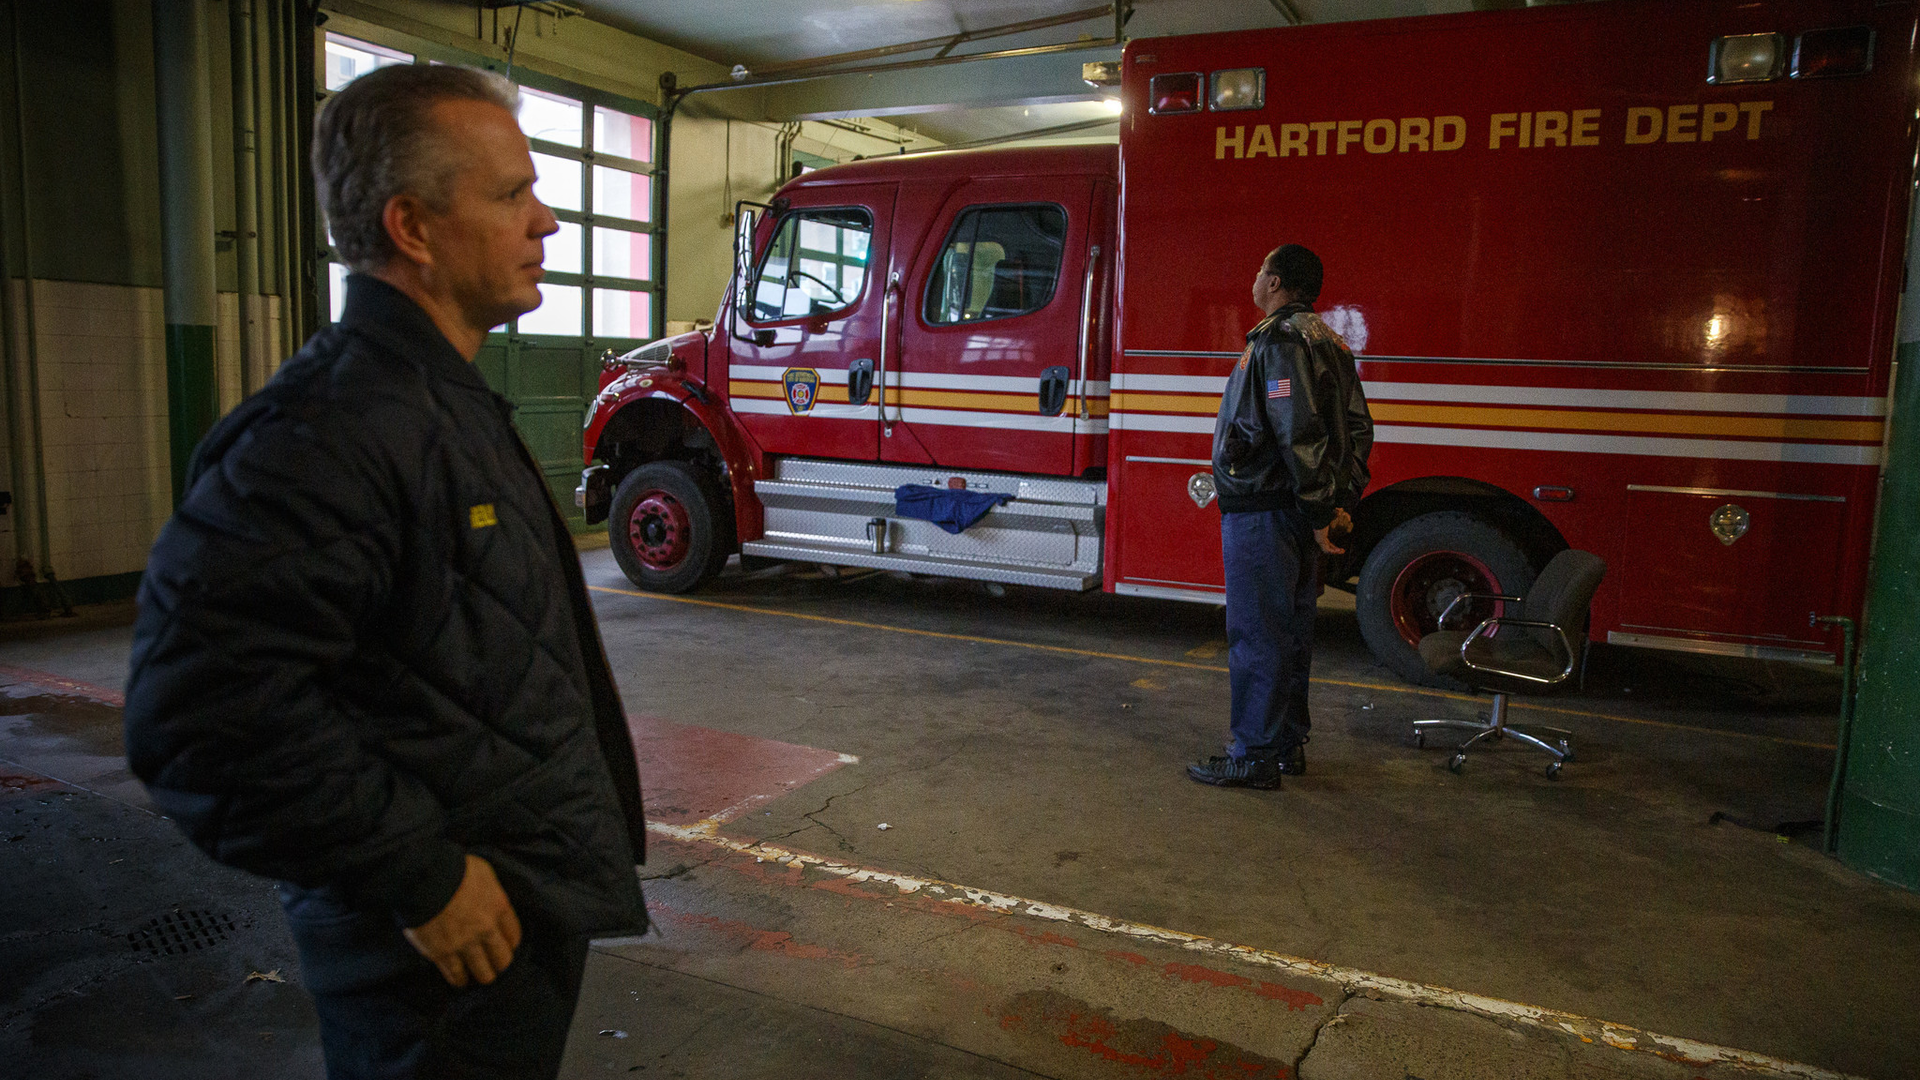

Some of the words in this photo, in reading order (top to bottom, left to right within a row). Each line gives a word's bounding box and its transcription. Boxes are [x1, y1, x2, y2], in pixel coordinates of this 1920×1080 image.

[1214, 115, 1467, 161] HARTFORD
[1488, 108, 1601, 150] FIRE
[1624, 100, 1775, 145] DEPT
